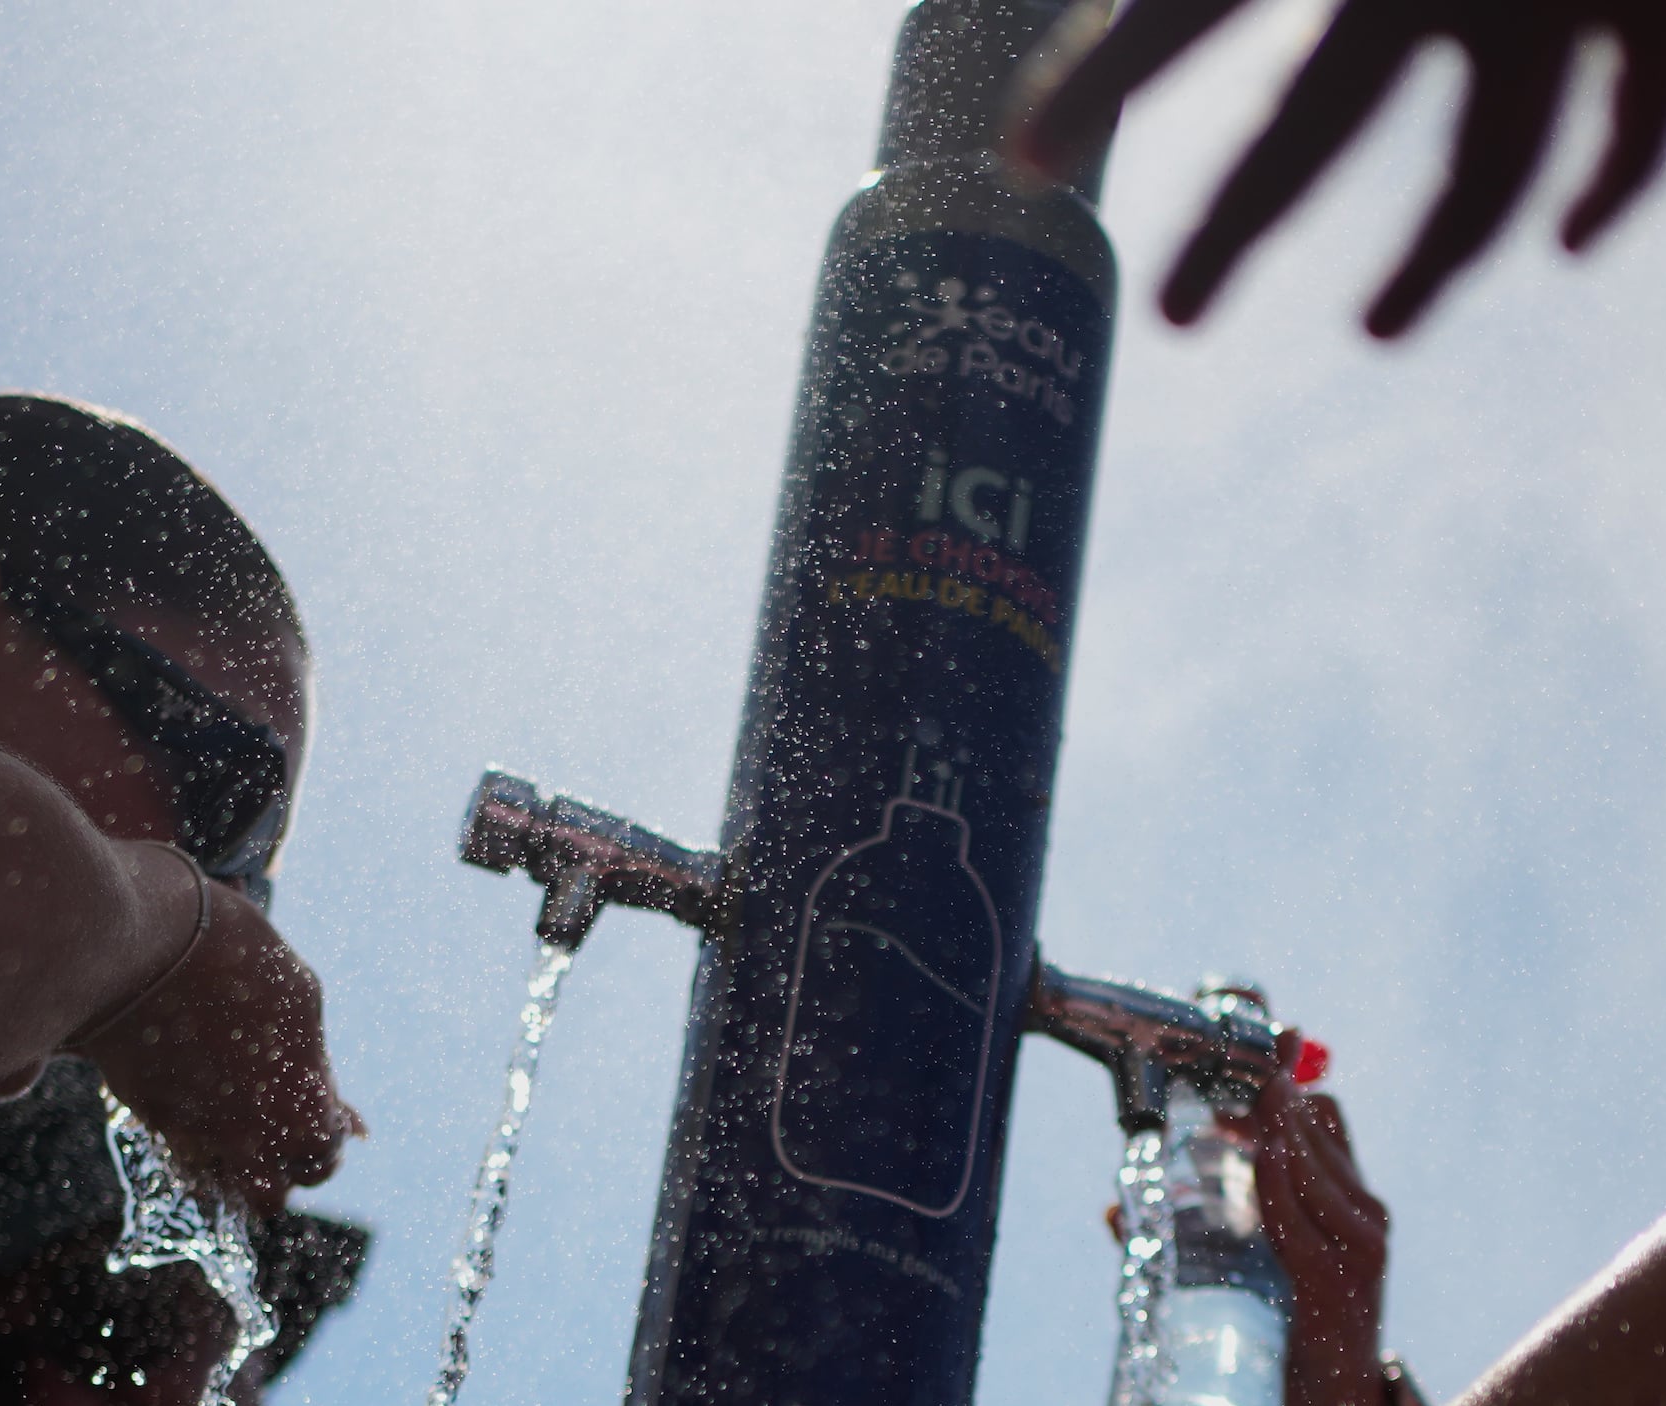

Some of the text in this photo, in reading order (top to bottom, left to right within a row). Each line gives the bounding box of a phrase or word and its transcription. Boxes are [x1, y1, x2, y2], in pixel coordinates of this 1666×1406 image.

[978, 306, 1082, 381] eau
[884, 338, 1074, 426] de Paris
[850, 530, 899, 565] JE
[938, 577, 989, 617] DE
